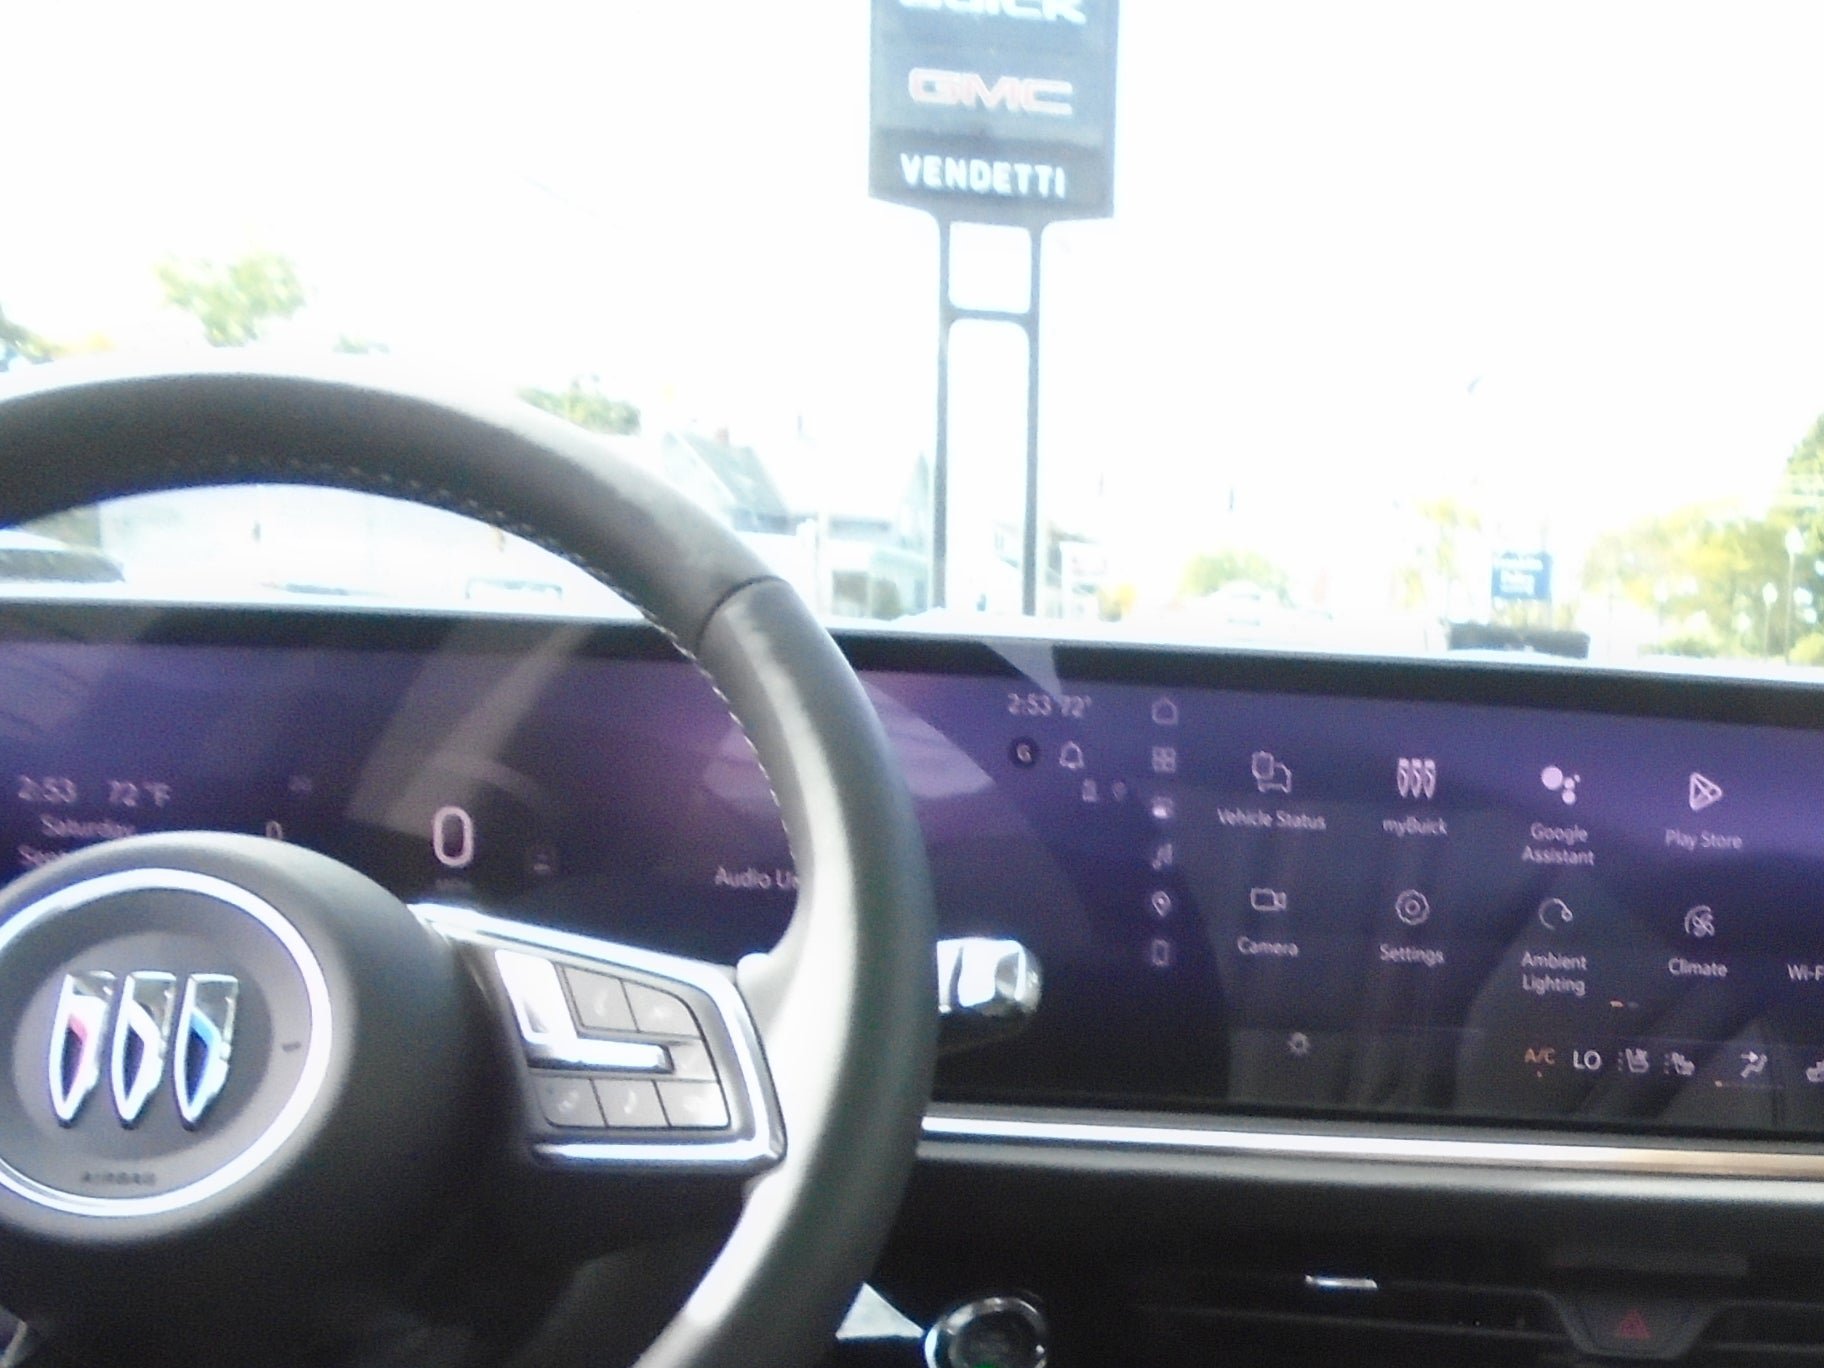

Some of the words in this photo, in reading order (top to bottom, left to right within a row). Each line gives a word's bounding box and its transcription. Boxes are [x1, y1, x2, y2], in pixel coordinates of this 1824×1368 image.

[908, 67, 1073, 116] GMC
[900, 153, 1066, 198] VENDETTI
[1216, 808, 1273, 828] Vehicle
[1275, 810, 1327, 830] Status
[1382, 815, 1448, 837] myBuick
[434, 805, 474, 868] 0
[1530, 822, 1588, 846] Google
[1665, 828, 1697, 851] Play
[1700, 830, 1744, 850] Store
[1521, 845, 1596, 866] Assistant
[714, 865, 772, 889] Audio
[1236, 935, 1299, 957] Camera
[1379, 943, 1444, 967] Settings
[1521, 951, 1587, 972] Ambient
[1667, 957, 1729, 978] Climate
[1521, 973, 1586, 997] Lighting
[1572, 1049, 1602, 1072] LO
